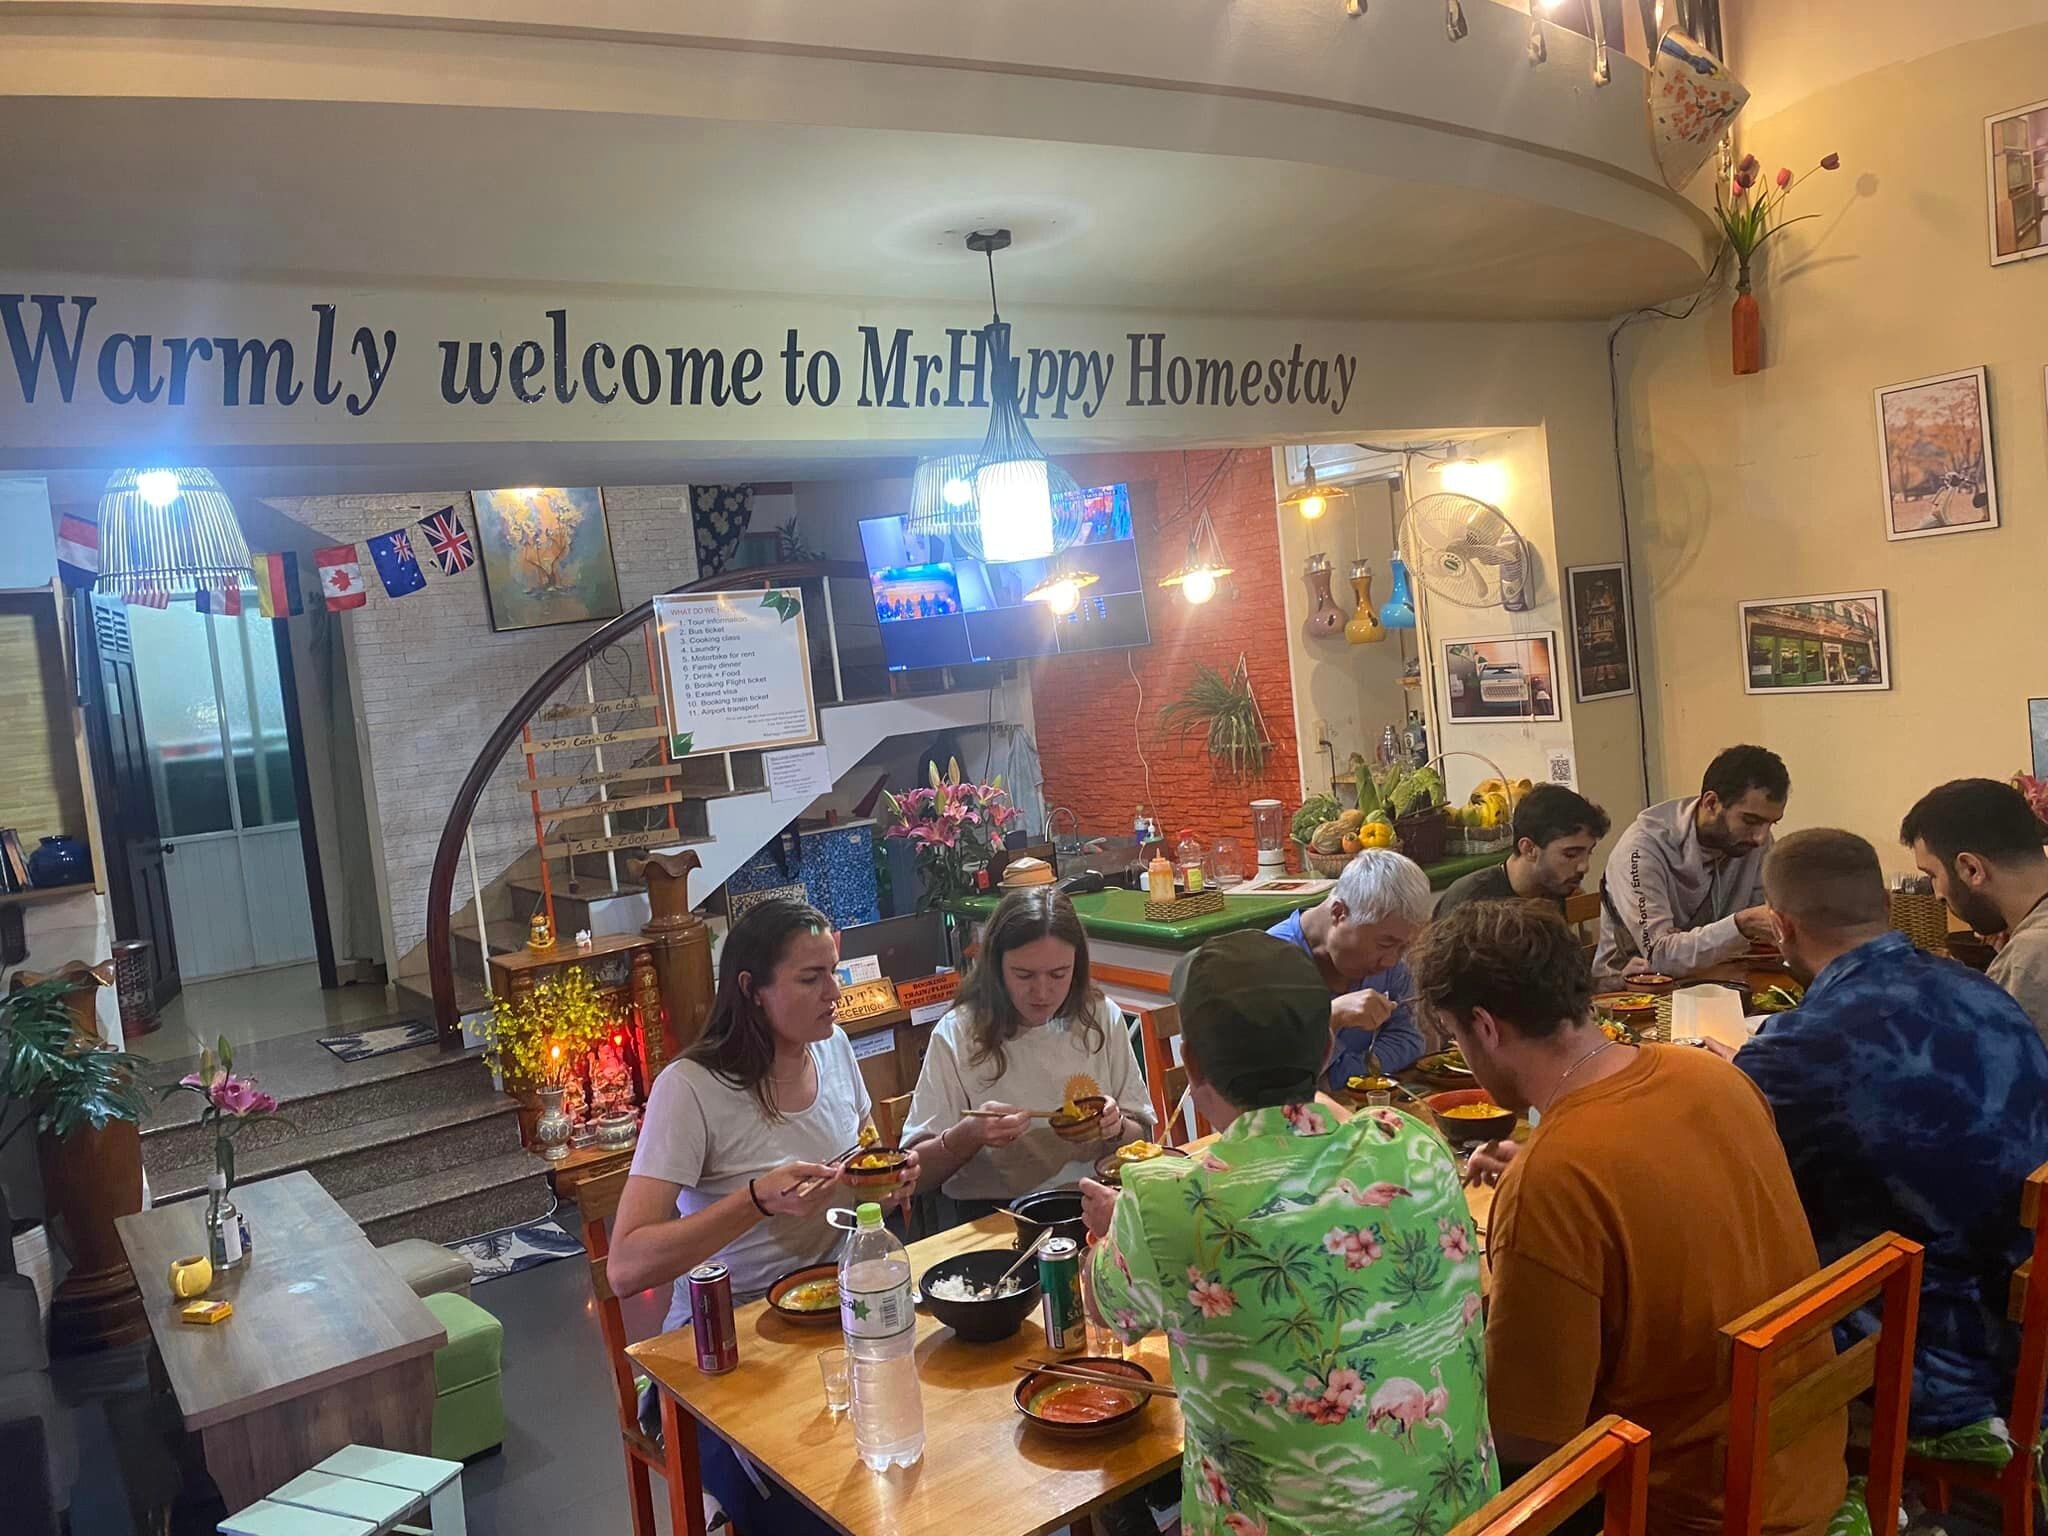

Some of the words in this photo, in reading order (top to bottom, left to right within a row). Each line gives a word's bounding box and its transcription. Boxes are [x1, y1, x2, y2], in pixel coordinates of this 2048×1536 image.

[0, 294, 397, 416] Warmly
[438, 309, 762, 407] welcome
[780, 329, 841, 407] to
[1126, 332, 1357, 415] Homestay
[671, 608, 691, 616] WHAT
[693, 607, 704, 615] DO
[705, 626, 725, 634] ticket
[689, 636, 720, 645] Cooking
[721, 634, 741, 642] class
[690, 645, 721, 653] Laundry
[691, 653, 728, 662] Motorbike
[729, 651, 739, 659] for
[741, 650, 756, 658] rent
[692, 663, 717, 671] Family
[718, 661, 742, 669] dinner
[693, 672, 712, 680] Drink
[694, 680, 724, 689] Booking
[725, 678, 746, 687] Flight
[747, 676, 767, 684] ticket
[695, 689, 721, 698] Extend
[701, 698, 731, 707] Booking
[732, 695, 748, 703] train
[750, 694, 769, 702] ticket
[701, 707, 726, 716] Airport
[727, 703, 759, 713] transport
[1629, 848, 1641, 888] Enterp.
